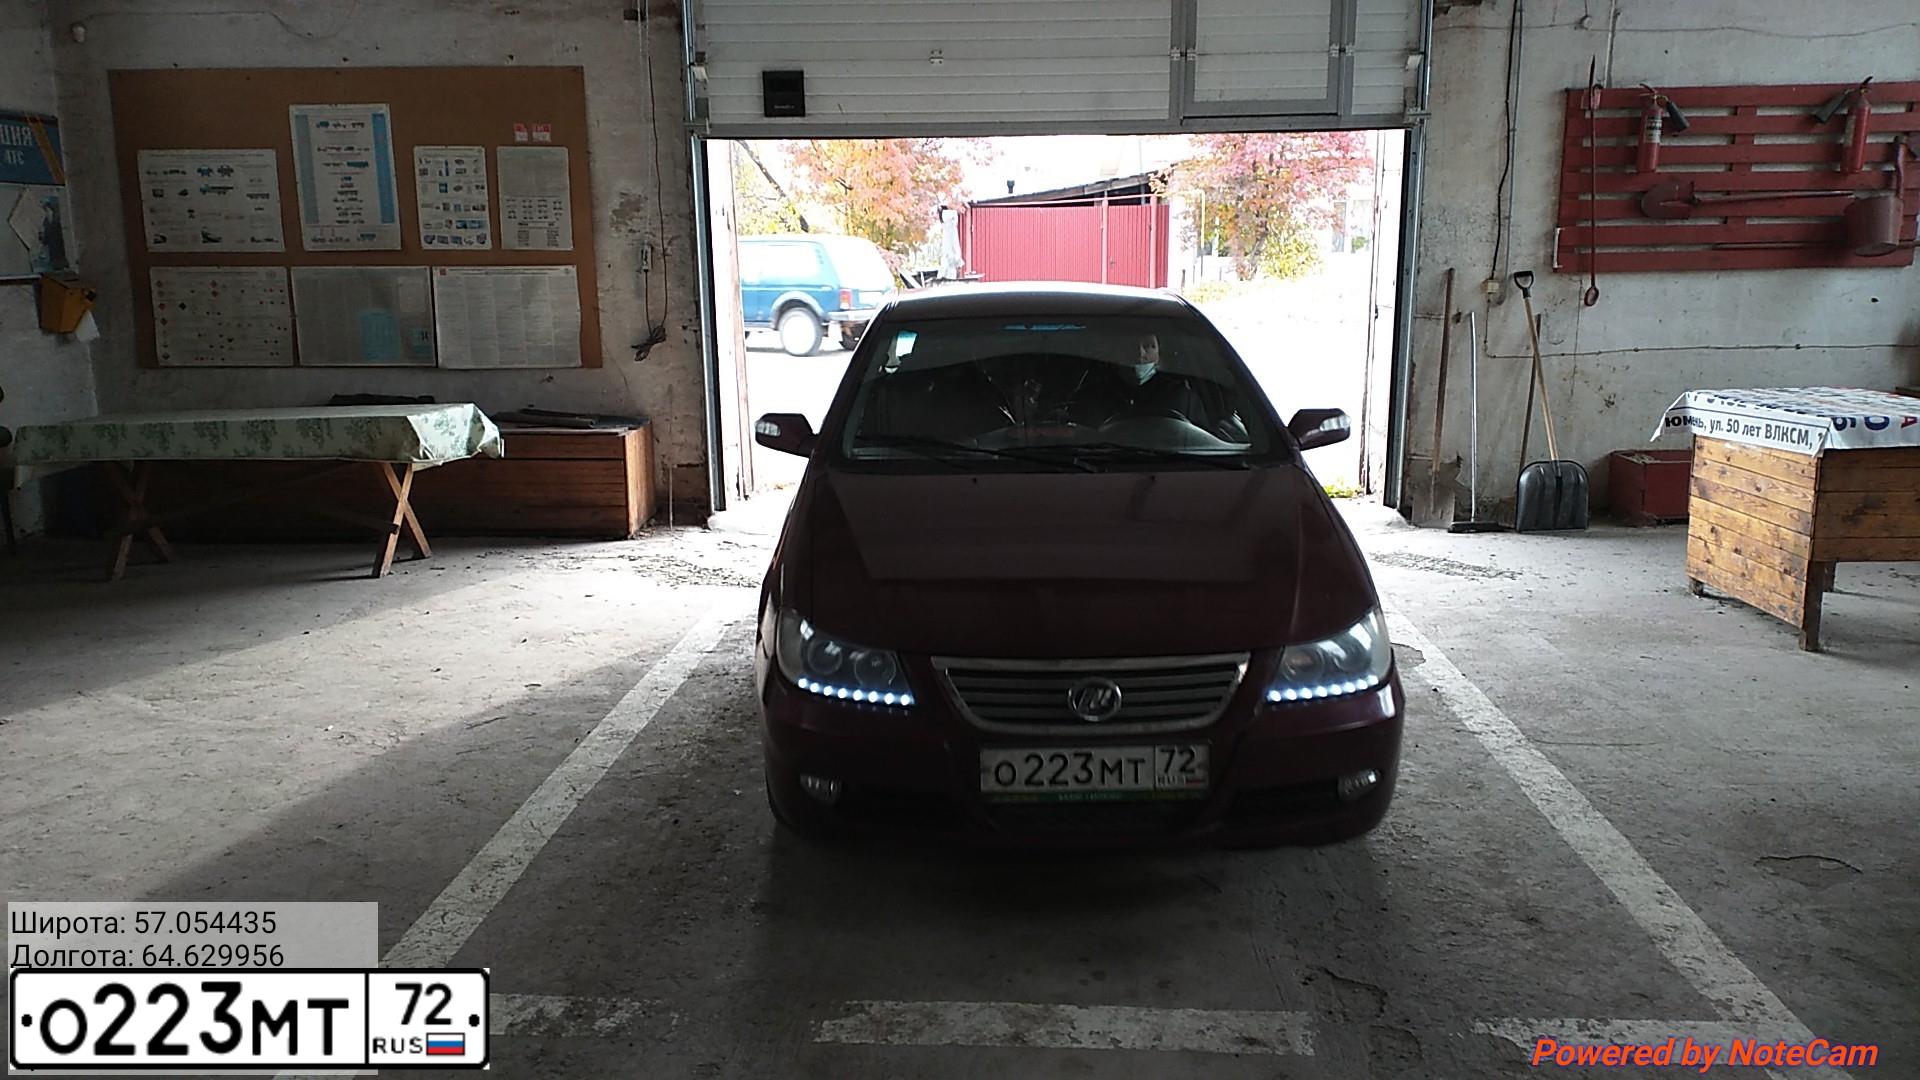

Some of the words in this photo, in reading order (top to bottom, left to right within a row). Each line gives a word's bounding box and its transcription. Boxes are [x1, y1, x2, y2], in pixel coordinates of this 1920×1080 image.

[1709, 419, 1724, 434] ул.
[1726, 418, 1740, 434] 50
[1742, 424, 1762, 438] лет
[1765, 424, 1813, 450] ВЛКСМ,
[1160, 749, 1196, 774] 72
